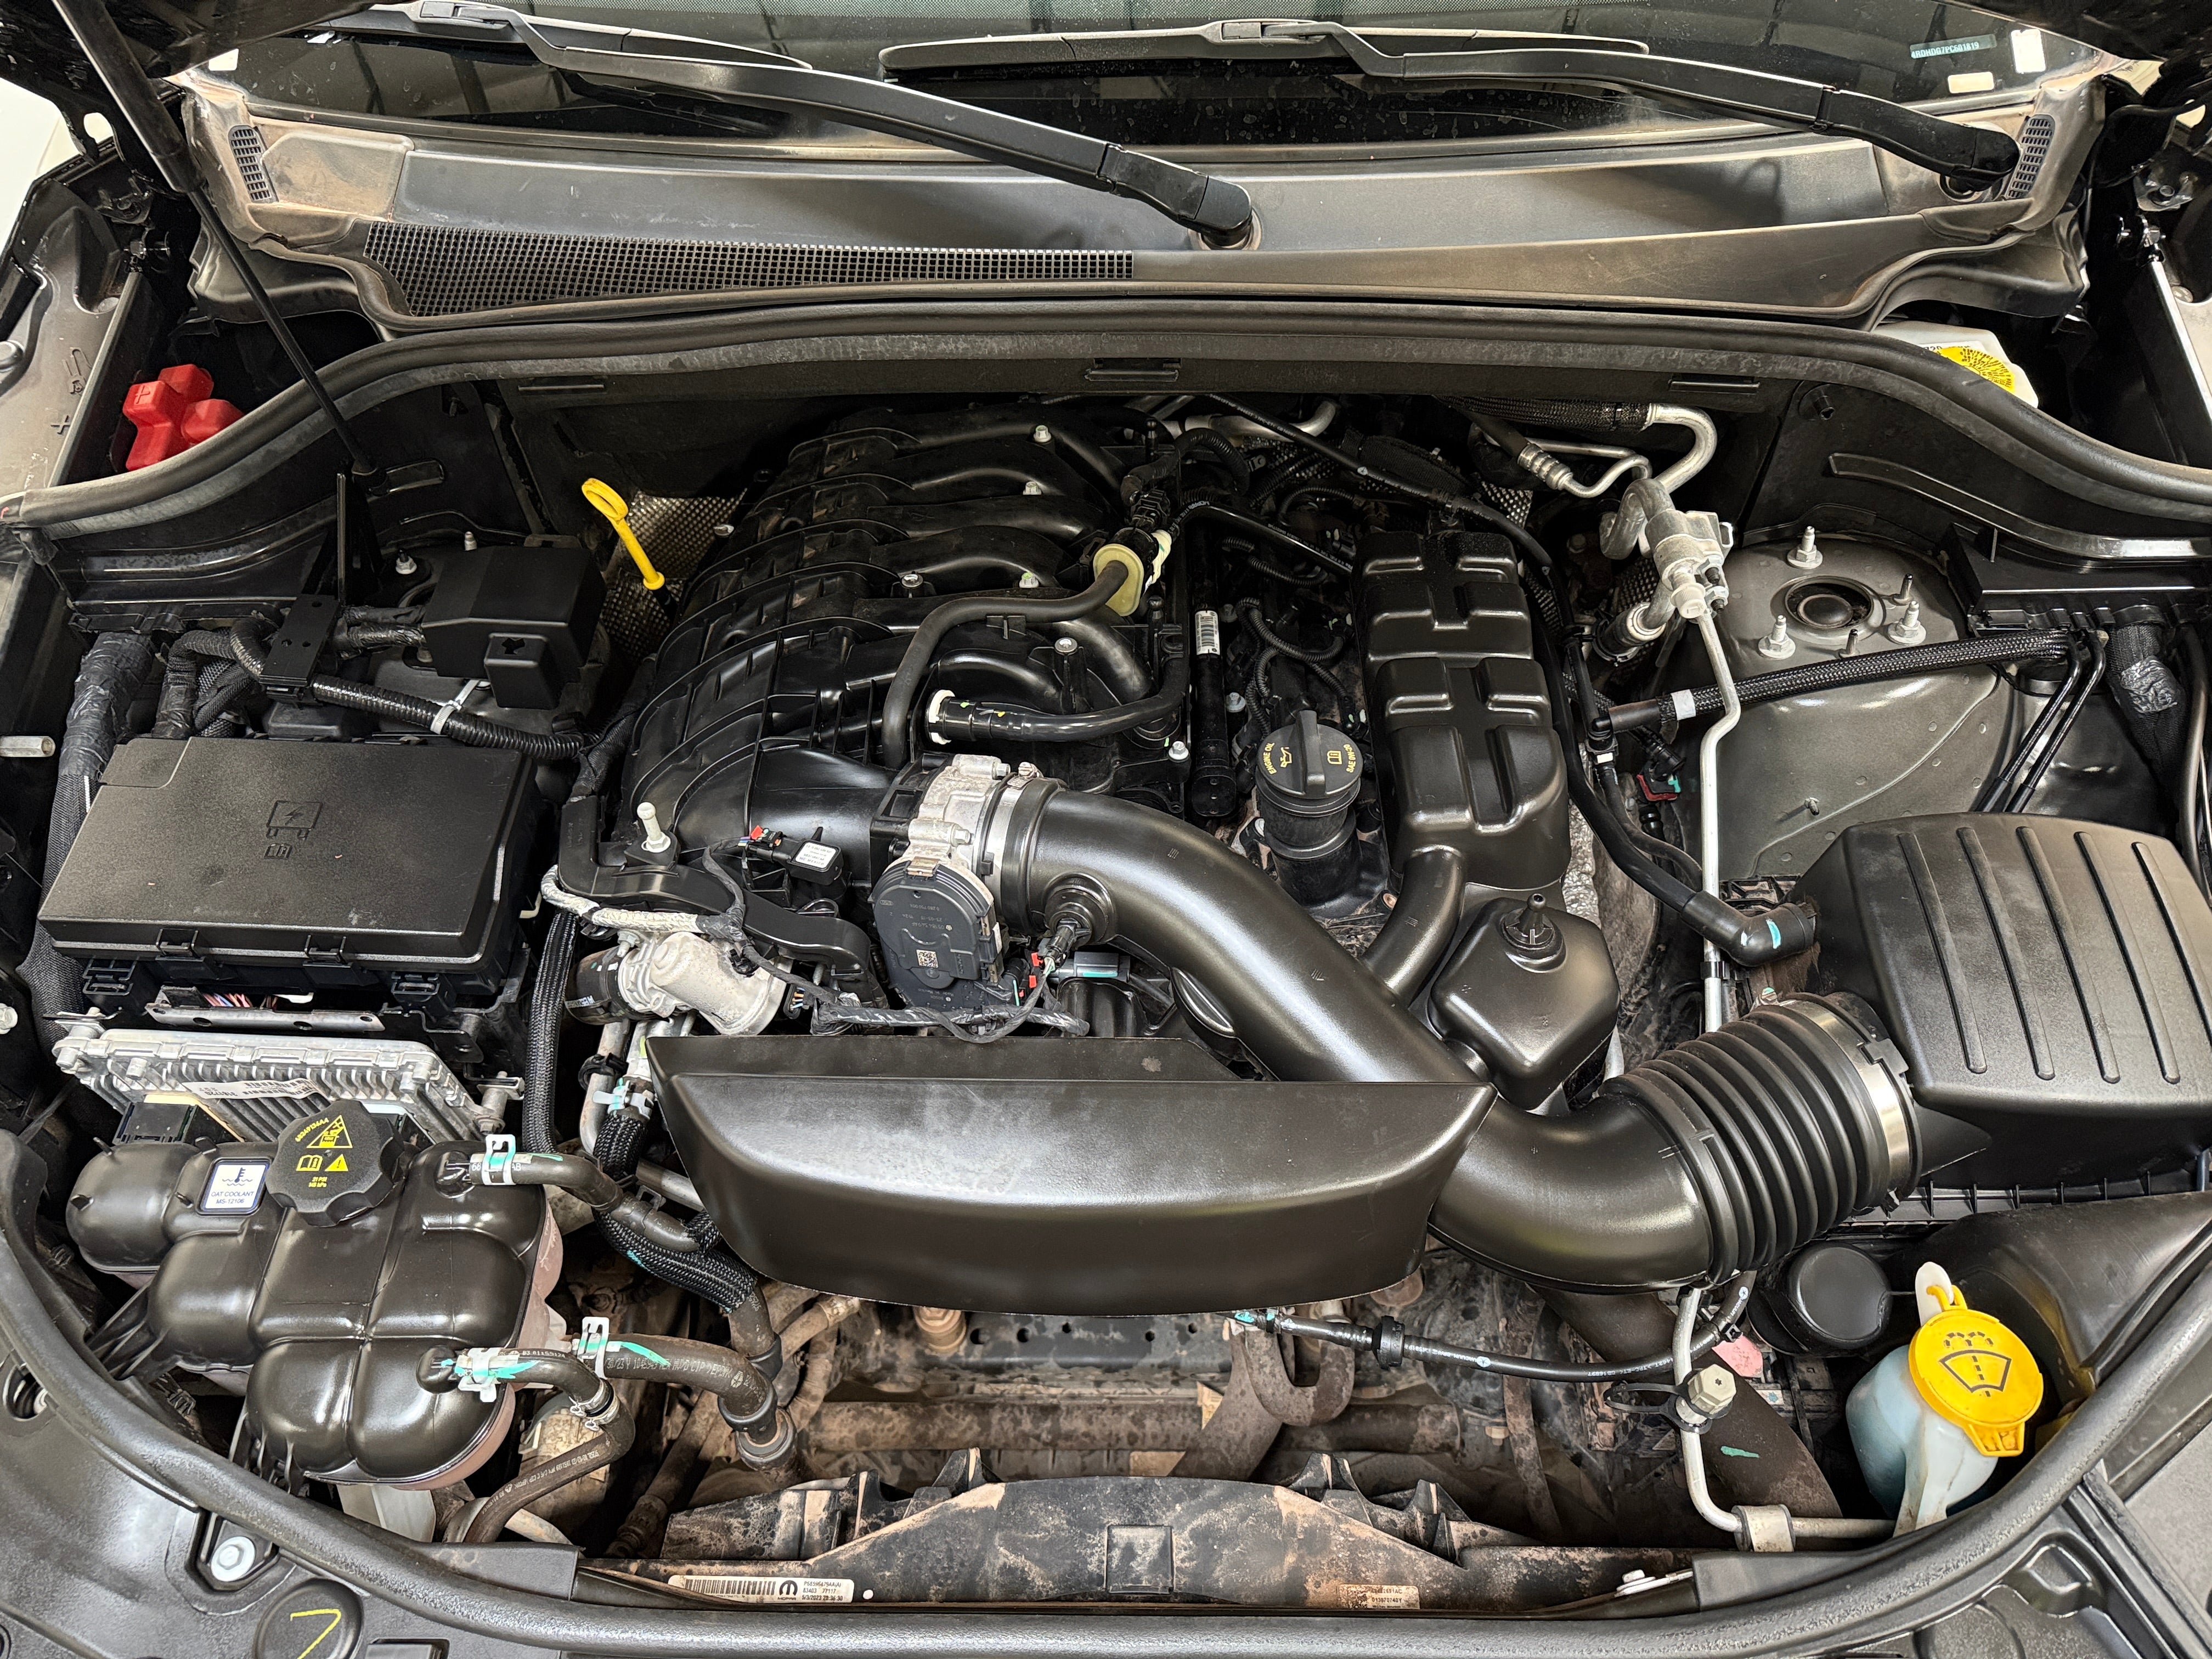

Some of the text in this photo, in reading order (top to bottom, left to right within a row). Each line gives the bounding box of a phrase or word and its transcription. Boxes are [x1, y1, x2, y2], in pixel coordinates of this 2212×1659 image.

[1263, 742, 1277, 775] ENGINE OIL
[1346, 761, 1356, 773] SAE
